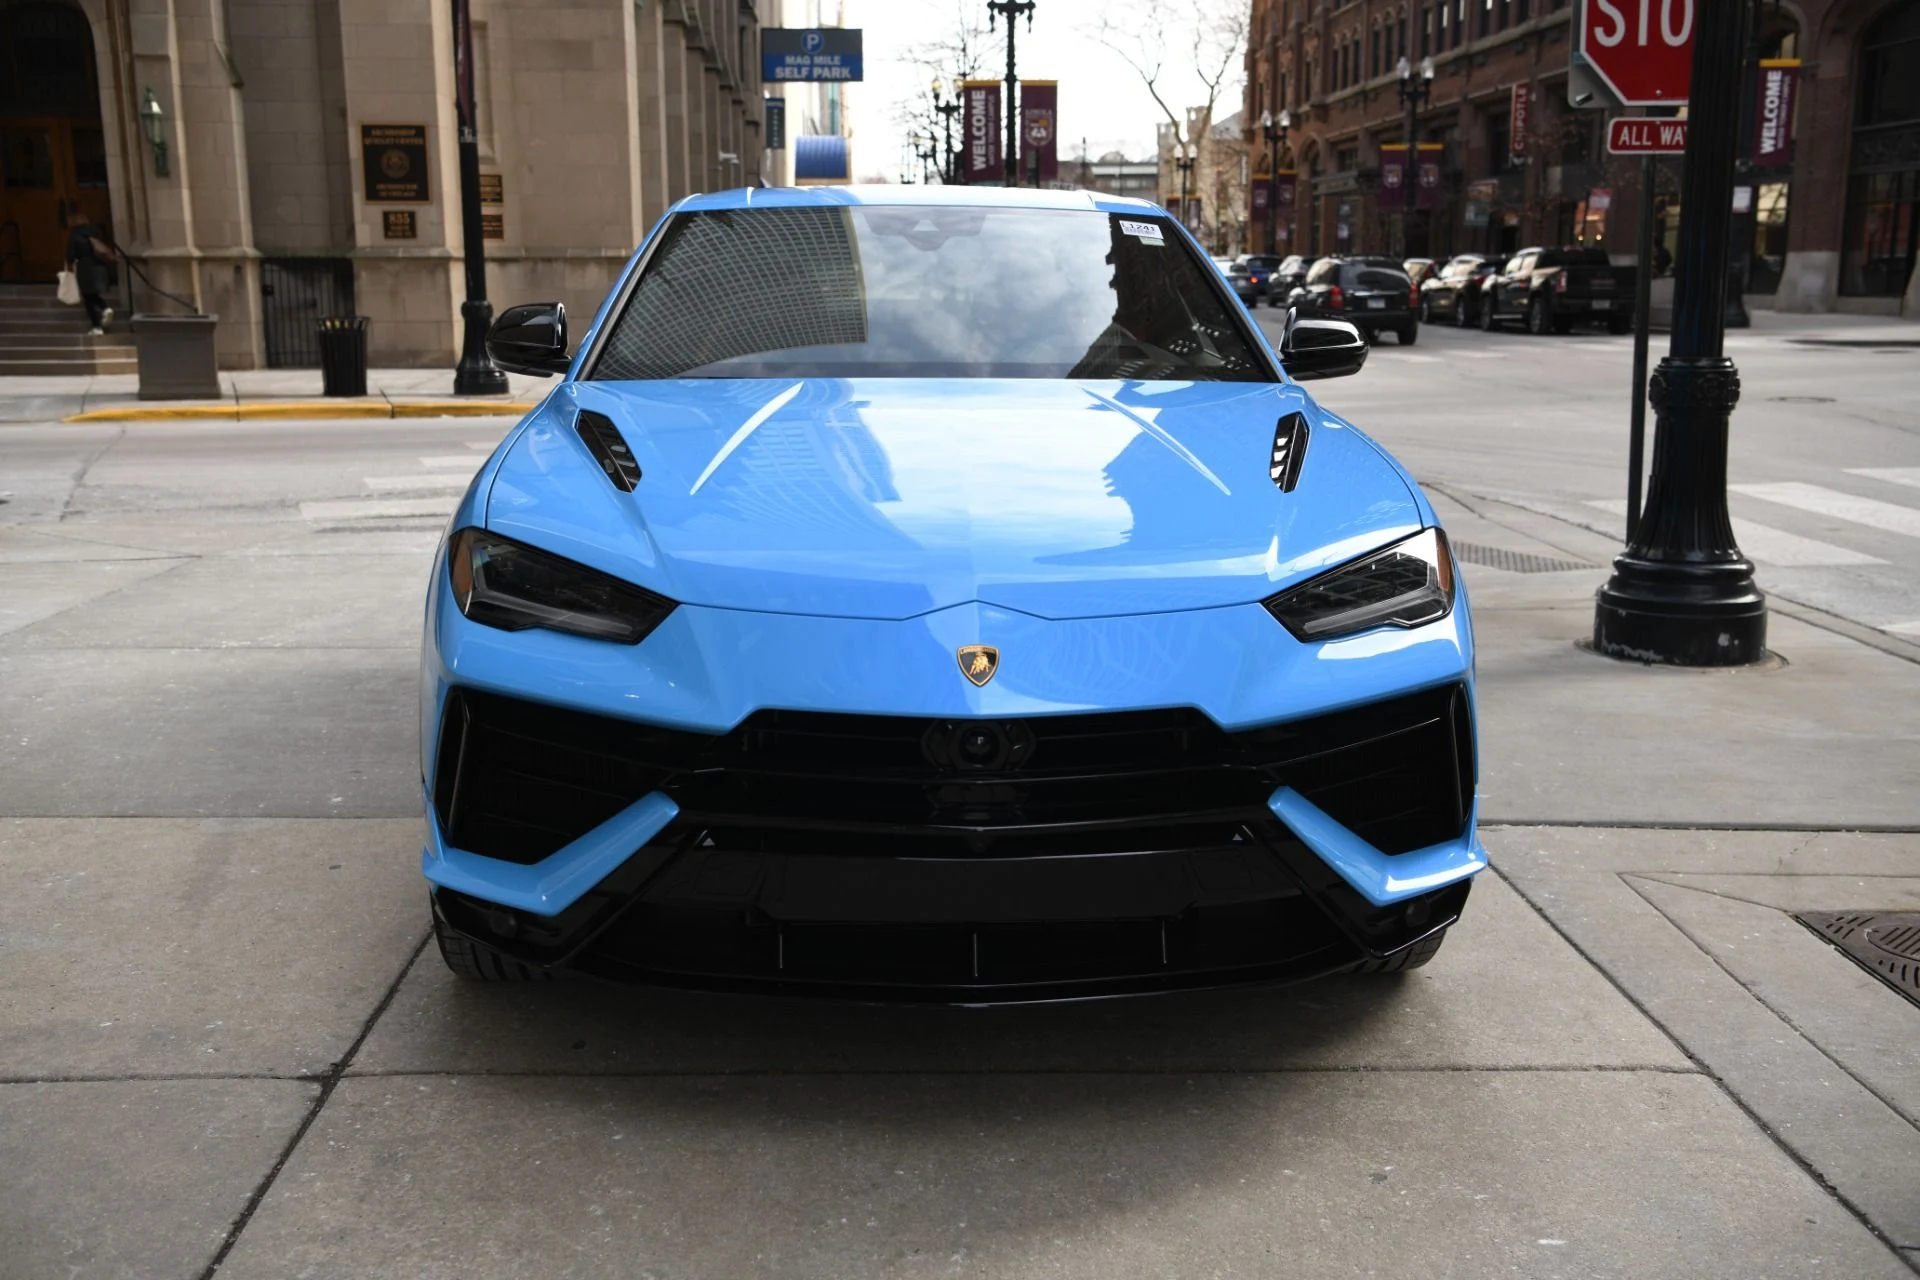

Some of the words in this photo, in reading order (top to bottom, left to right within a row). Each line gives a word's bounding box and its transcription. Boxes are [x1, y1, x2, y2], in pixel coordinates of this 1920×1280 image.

[1594, 0, 1694, 47] STO
[775, 66, 809, 79] SELF
[812, 67, 851, 79] PARK
[785, 56, 811, 65] MAG
[814, 56, 841, 65] MILE
[971, 89, 987, 171] WELCOME
[1515, 87, 1527, 150] CHIPOTLE
[1759, 70, 1782, 154] WELCOME
[1618, 127, 1652, 145] ALL
[1660, 126, 1687, 146] WA
